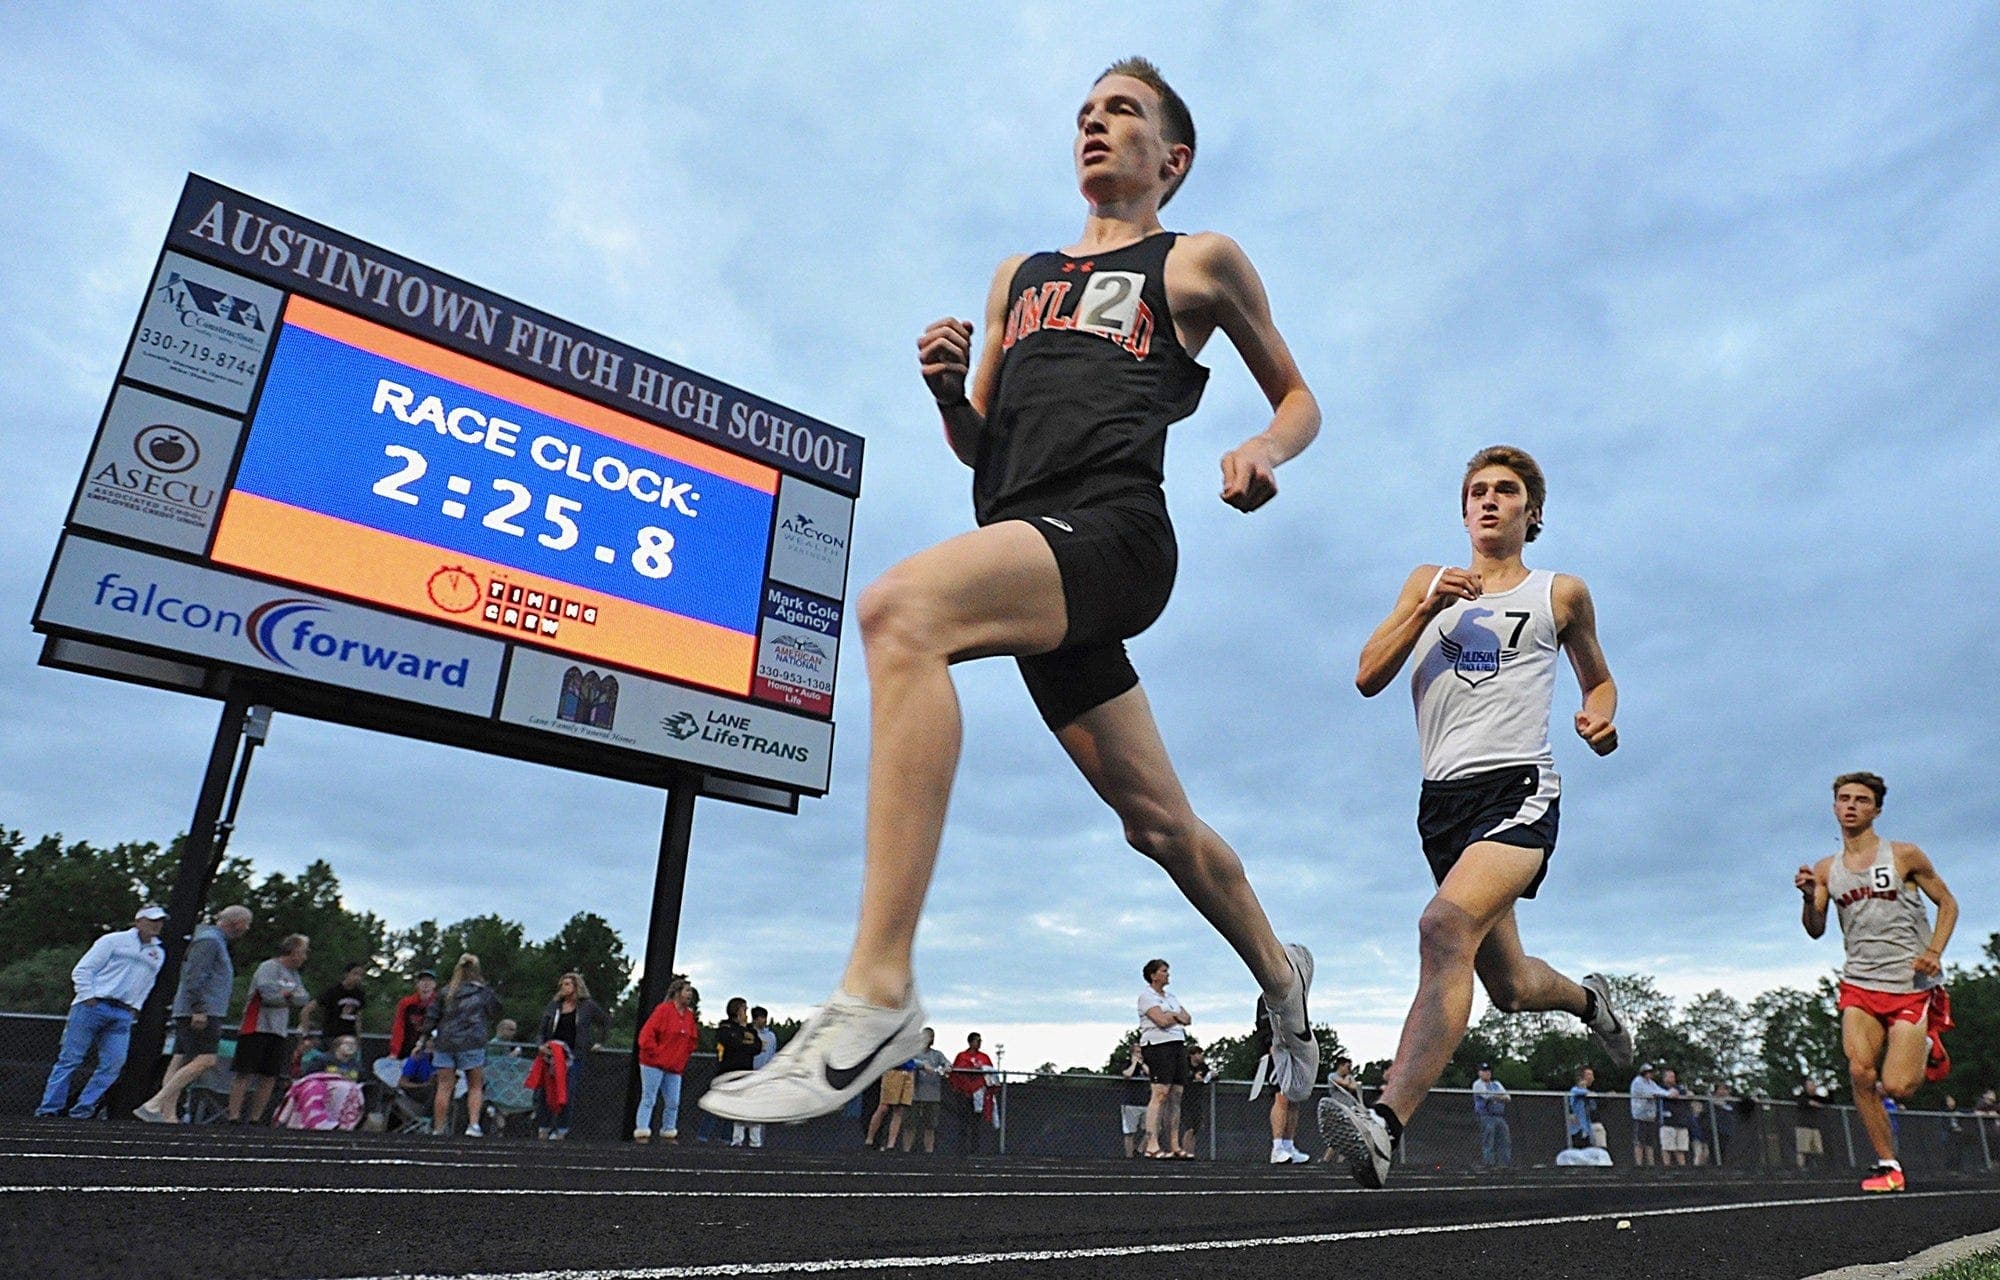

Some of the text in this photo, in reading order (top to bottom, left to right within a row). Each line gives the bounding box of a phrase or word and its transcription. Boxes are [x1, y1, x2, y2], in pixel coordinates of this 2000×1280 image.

[1085, 275, 1132, 330] 2
[140, 327, 257, 377] 330-719-8744
[189, 200, 852, 480] AUSTINTOWN FITCH HIGH SCHOOL
[372, 379, 701, 518] RACE CLOCK:
[94, 461, 215, 509] ASECU
[372, 444, 675, 579] 2:25.8
[781, 518, 844, 549] ALCYON
[490, 582, 597, 623] TIMING
[768, 589, 840, 621] Mark Cole
[775, 605, 830, 632] Agency
[95, 573, 469, 689] falcon forward
[1504, 611, 1531, 649] 7
[774, 645, 822, 666] AMERICAN
[775, 654, 820, 673] NATIONAL
[1461, 651, 1496, 663] HUDSON
[758, 664, 832, 693] 330-953-1308
[767, 680, 822, 701] Home Auto
[785, 694, 802, 705] Life
[706, 710, 751, 731] LANE
[701, 725, 809, 763] LifeTRANS
[1875, 866, 1890, 889] 5
